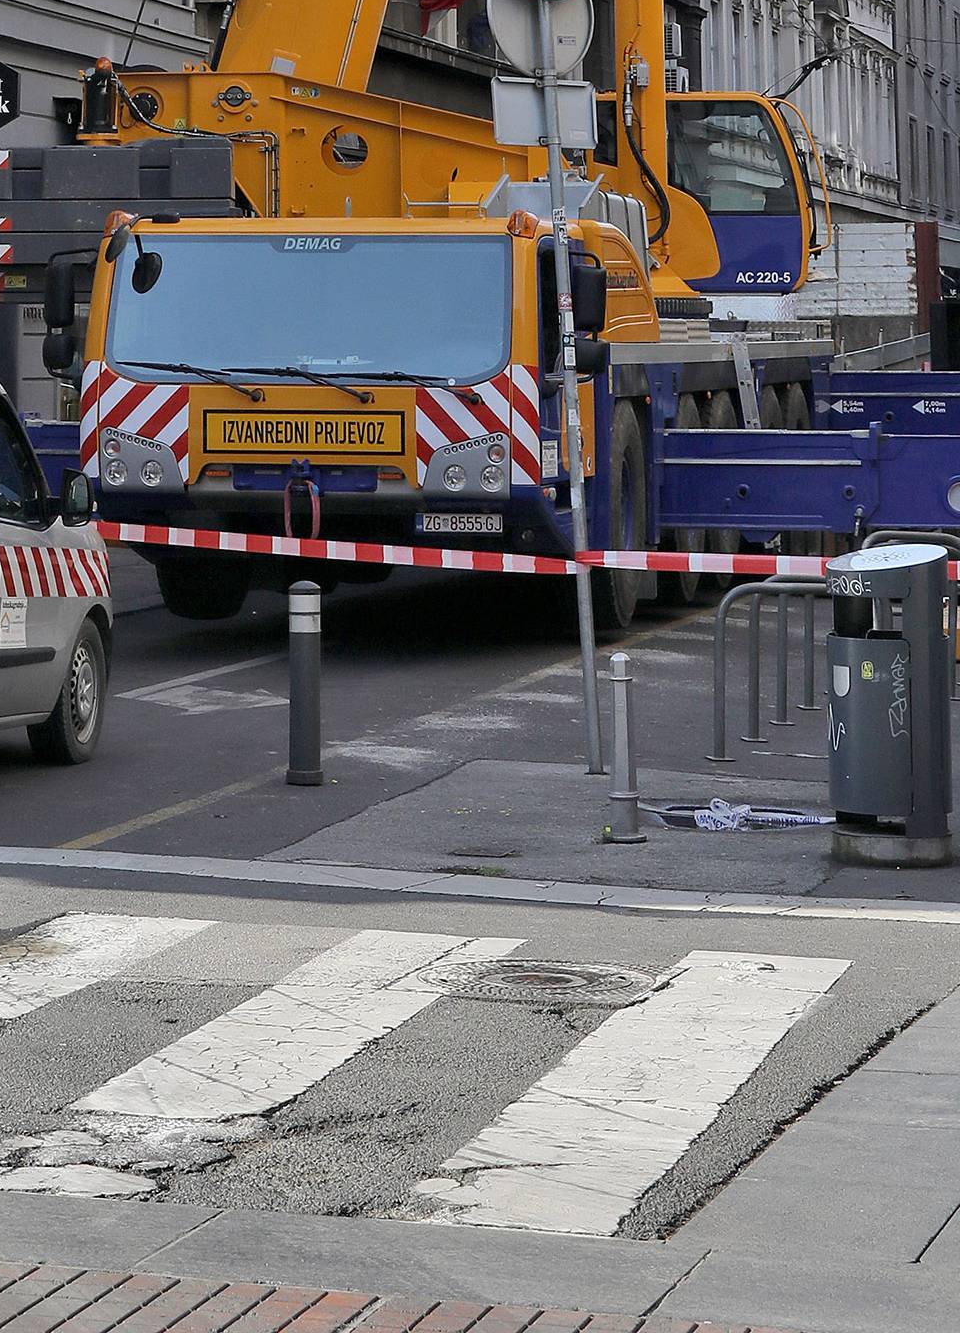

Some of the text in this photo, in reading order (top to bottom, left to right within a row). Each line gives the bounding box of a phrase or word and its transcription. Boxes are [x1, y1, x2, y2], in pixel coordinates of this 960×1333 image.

[284, 237, 342, 250] DEMAG
[736, 272, 792, 284] AC 220-5
[222, 421, 385, 445] IZVANREDNI PRIJEVOZ
[425, 515, 441, 531] ZG
